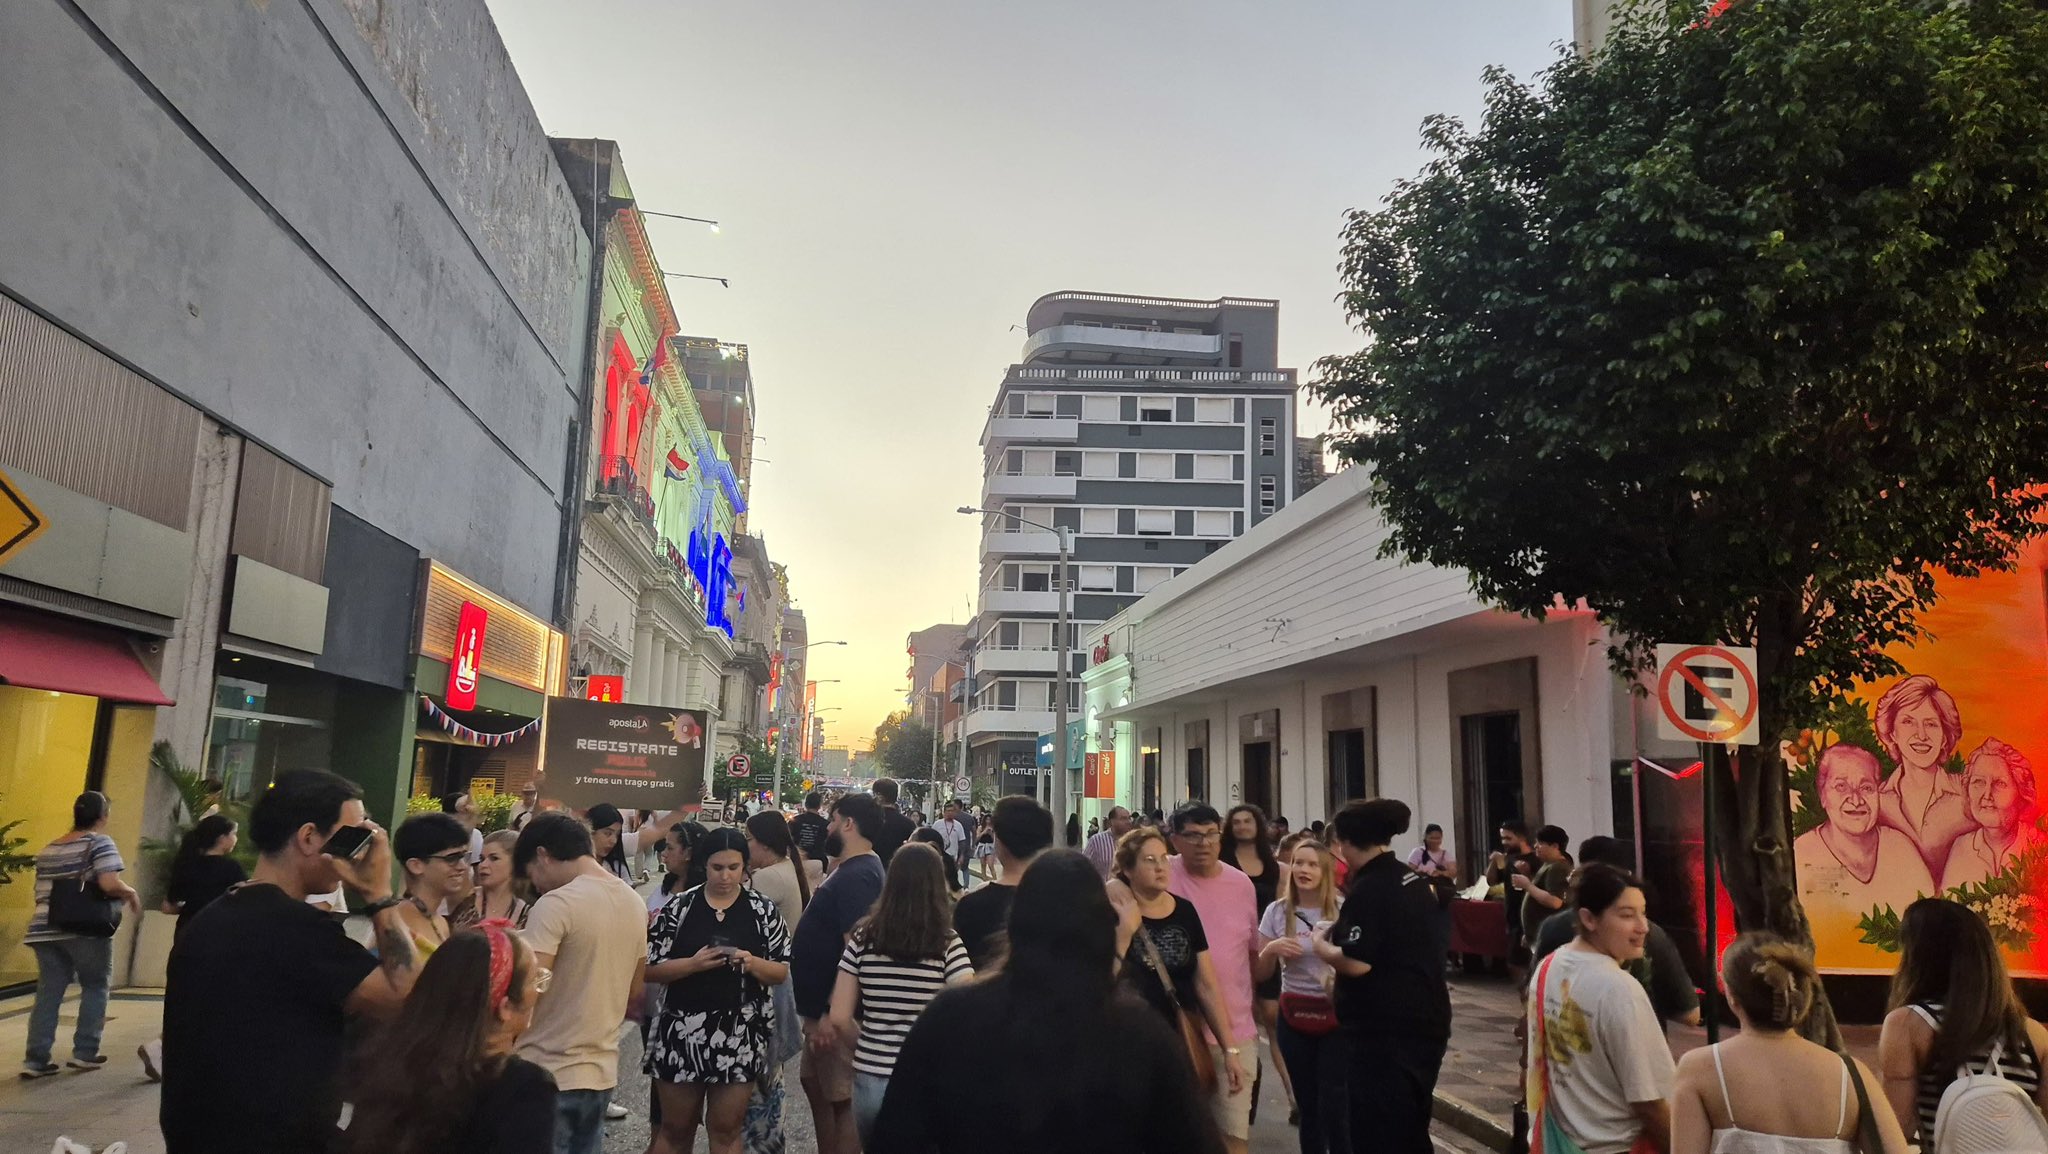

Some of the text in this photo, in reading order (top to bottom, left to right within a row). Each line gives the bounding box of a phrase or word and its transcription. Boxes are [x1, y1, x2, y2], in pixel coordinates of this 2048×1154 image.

[1684, 666, 1734, 721] E
[576, 738, 678, 757] REGISTRATE
[1009, 767, 1037, 776] OUTLET
[1088, 756, 1096, 776] Claro
[1102, 755, 1110, 775] Claro
[575, 776, 582, 785] y
[583, 775, 609, 785] tenes
[625, 778, 648, 788] trago
[650, 779, 675, 789] gratis
